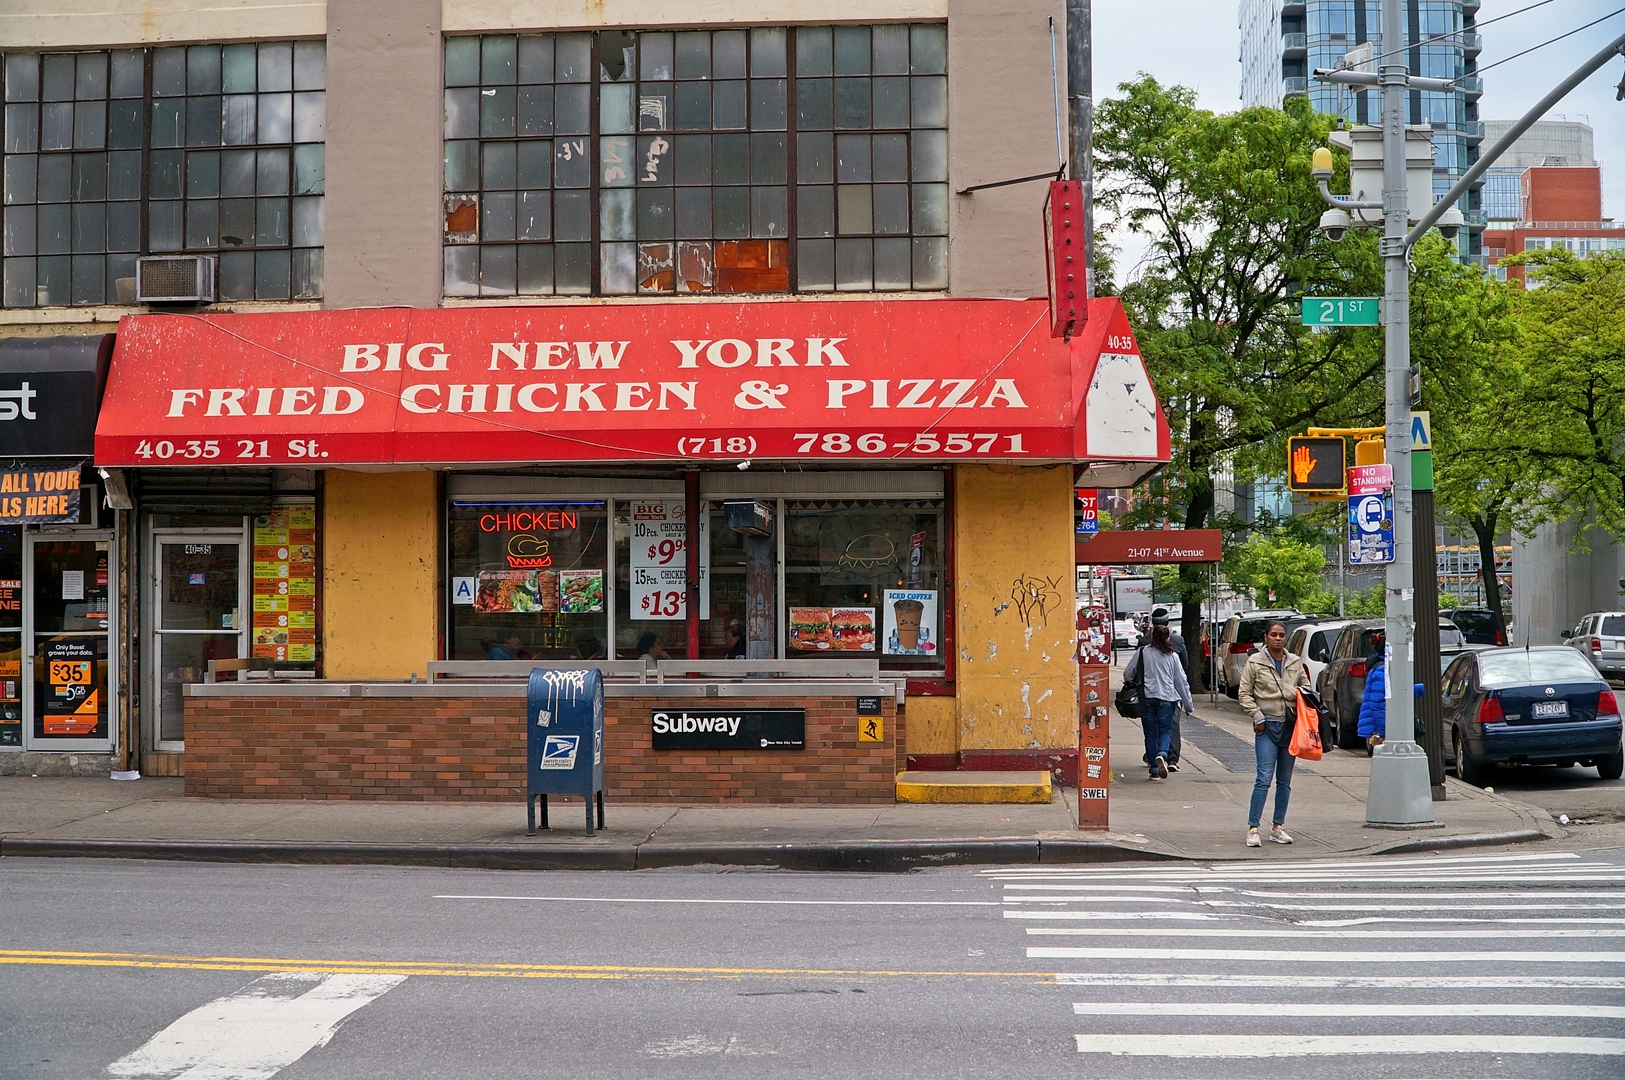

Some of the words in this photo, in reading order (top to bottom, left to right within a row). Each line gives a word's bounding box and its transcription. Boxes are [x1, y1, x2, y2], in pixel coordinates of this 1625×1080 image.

[1319, 301, 1344, 322] 21
[1349, 300, 1364, 312] ST
[1107, 334, 1132, 350] 40-35
[339, 342, 451, 373] BIG
[487, 340, 631, 371] NEW
[670, 338, 850, 369] YORK
[165, 386, 365, 418] FRIED
[399, 381, 699, 413] CHICKEN
[734, 380, 789, 409] &
[825, 378, 1029, 408] PIZZA
[134, 439, 221, 459] 40-35
[236, 439, 272, 458] 21
[287, 438, 329, 458] St.
[677, 436, 757, 455] (718)
[792, 432, 1030, 454] 786-5571
[1352, 475, 1387, 487] STANDING
[1362, 468, 1376, 477] NO
[1, 473, 29, 493] ALL
[33, 470, 79, 492] YOUR
[25, 494, 68, 516] HERE
[636, 505, 664, 513] BIG
[480, 512, 577, 532] CHICKEN
[634, 523, 646, 537] 10
[646, 528, 659, 537] Pcs.
[185, 544, 212, 554] 40-35
[1127, 547, 1151, 558] 21-07
[1170, 547, 1205, 557] Avenue
[634, 568, 646, 584] 15
[646, 575, 659, 585] Pcs.
[456, 580, 471, 597] A
[55, 644, 68, 652] Only
[52, 664, 83, 682] $35
[653, 713, 741, 736] Subway
[1083, 788, 1106, 799] SWEL
